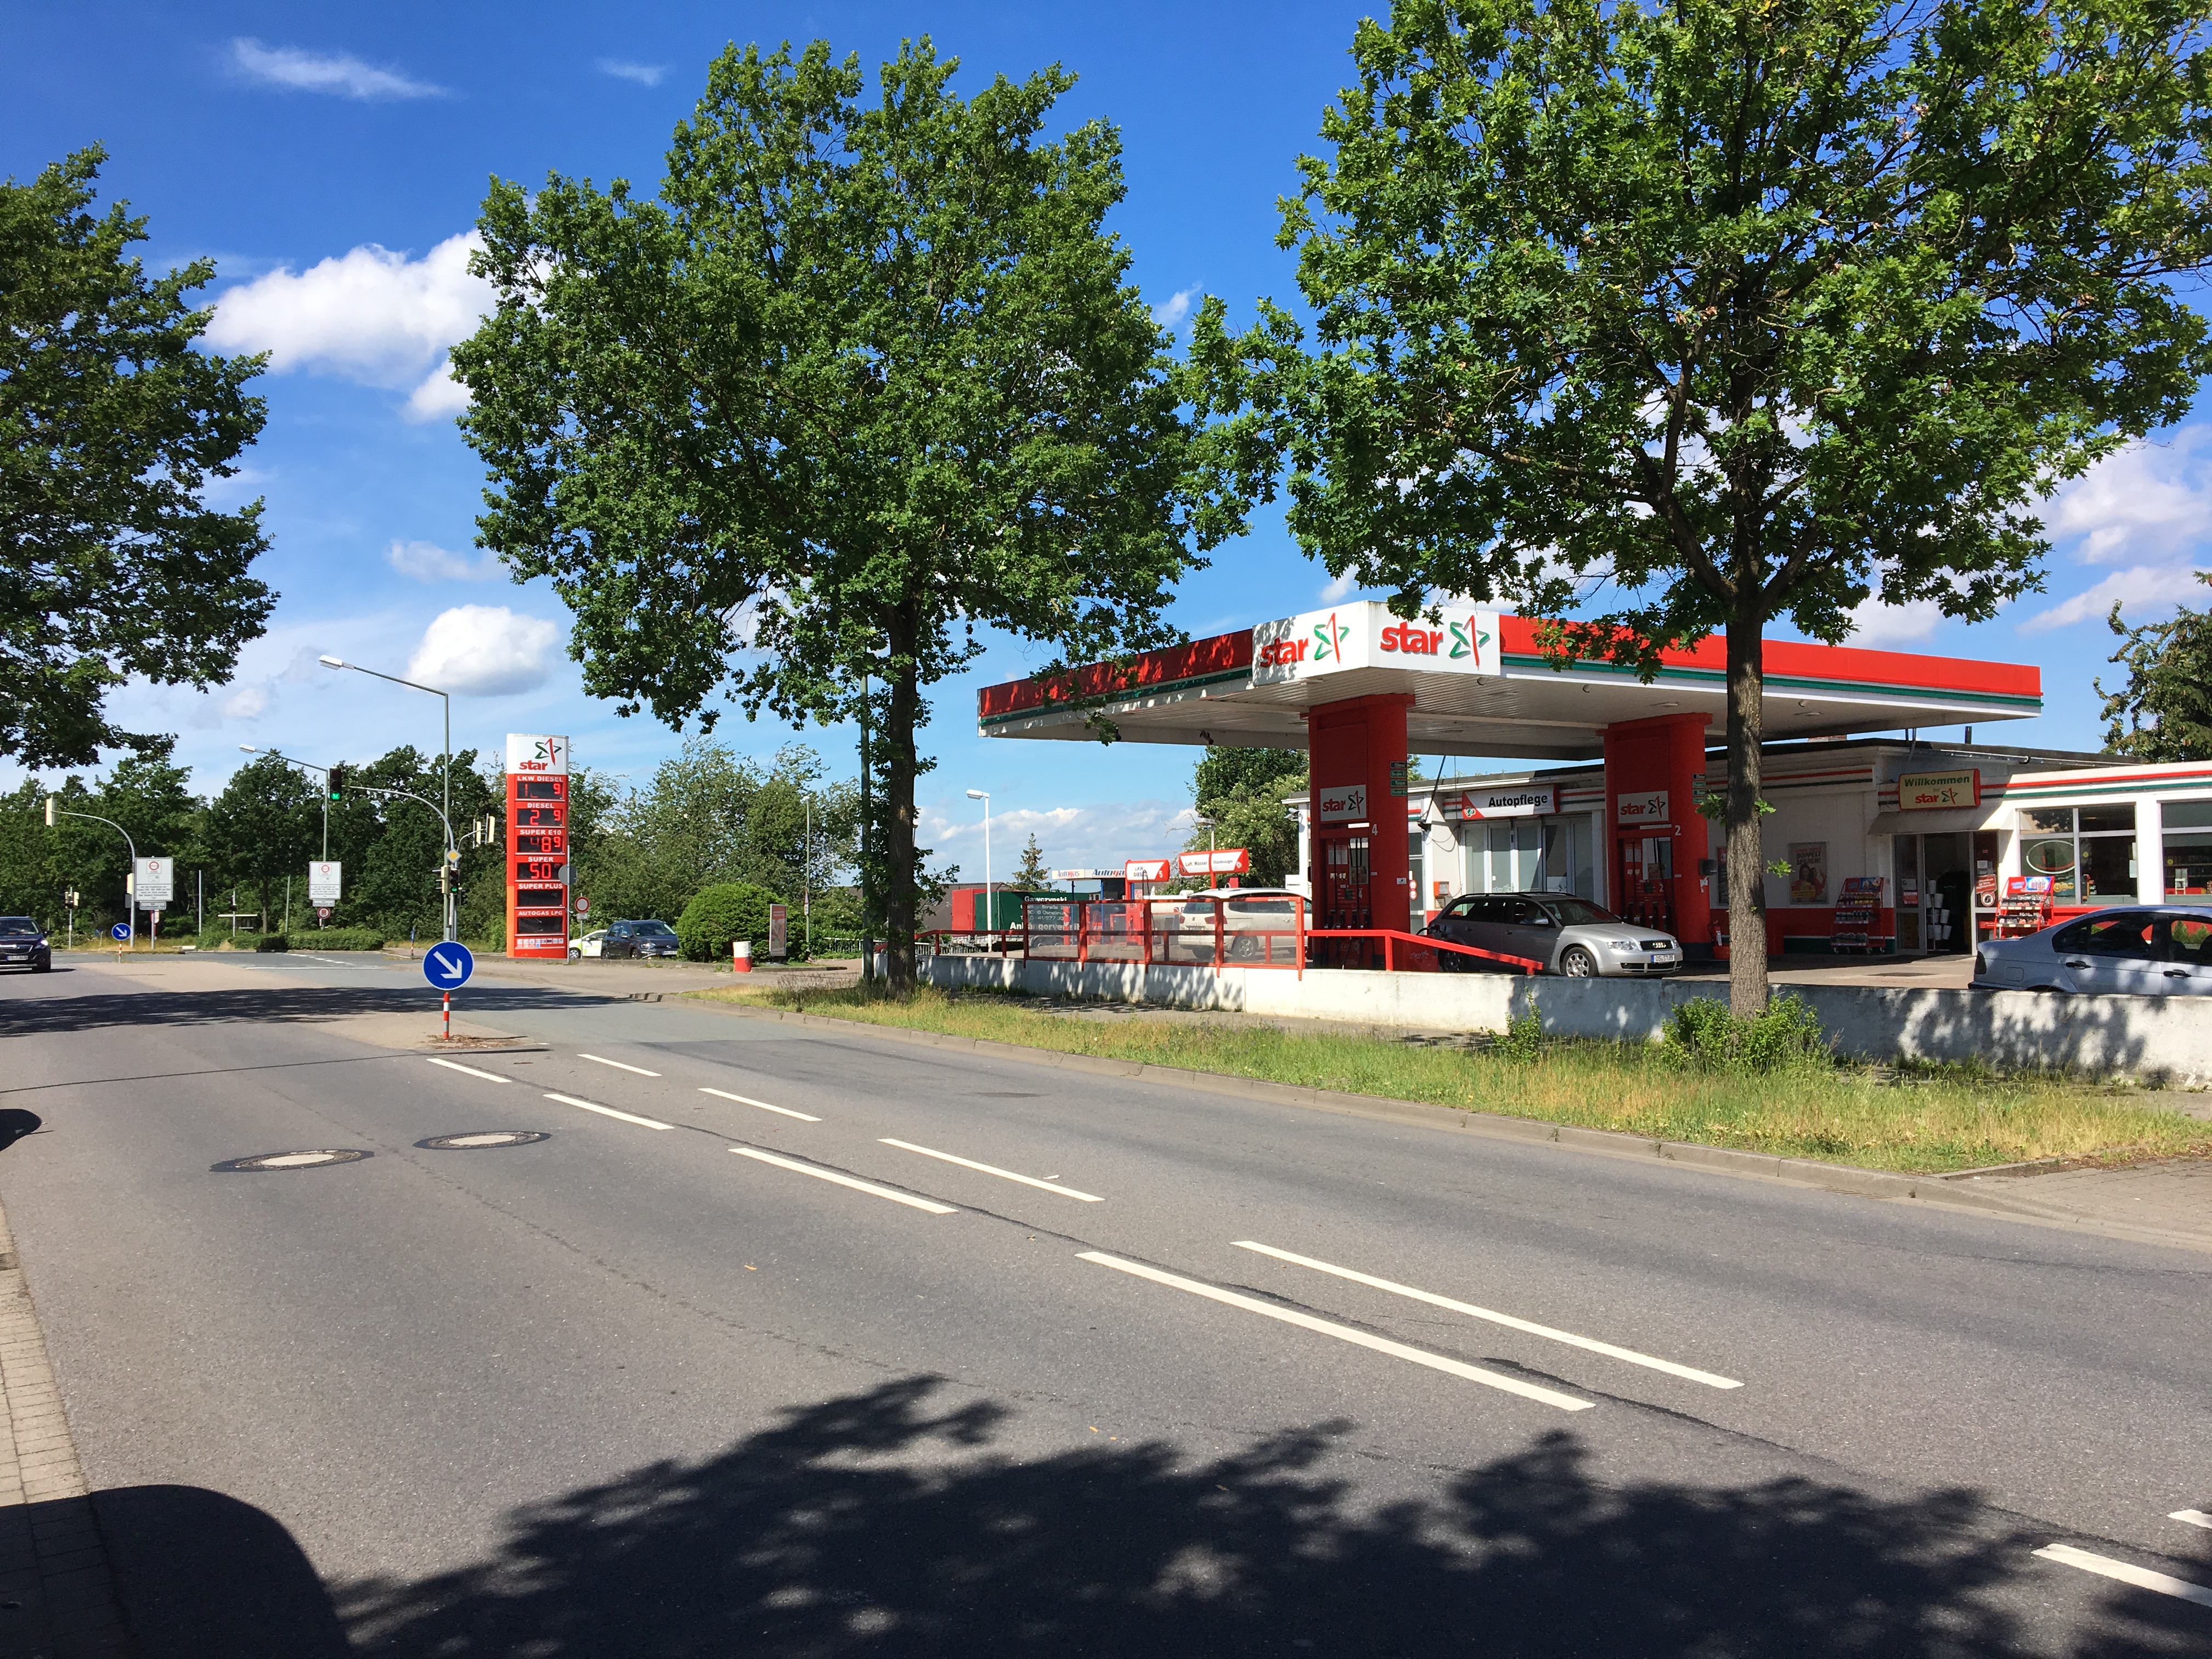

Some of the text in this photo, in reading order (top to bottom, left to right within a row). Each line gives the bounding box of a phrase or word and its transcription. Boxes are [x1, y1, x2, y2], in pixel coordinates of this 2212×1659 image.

[1380, 621, 1443, 654] star
[1260, 636, 1309, 668] star
[519, 759, 548, 770] star
[1904, 776, 1970, 787] Willkommen
[1488, 794, 1548, 808] Autopflege
[1915, 793, 1939, 804] star
[1322, 798, 1346, 812] star
[1620, 803, 1645, 815] star
[1372, 823, 1378, 836] 4
[1675, 825, 1681, 836] 2
[1796, 851, 1822, 859] DOPPELT
[1092, 869, 1125, 877] Autoga
